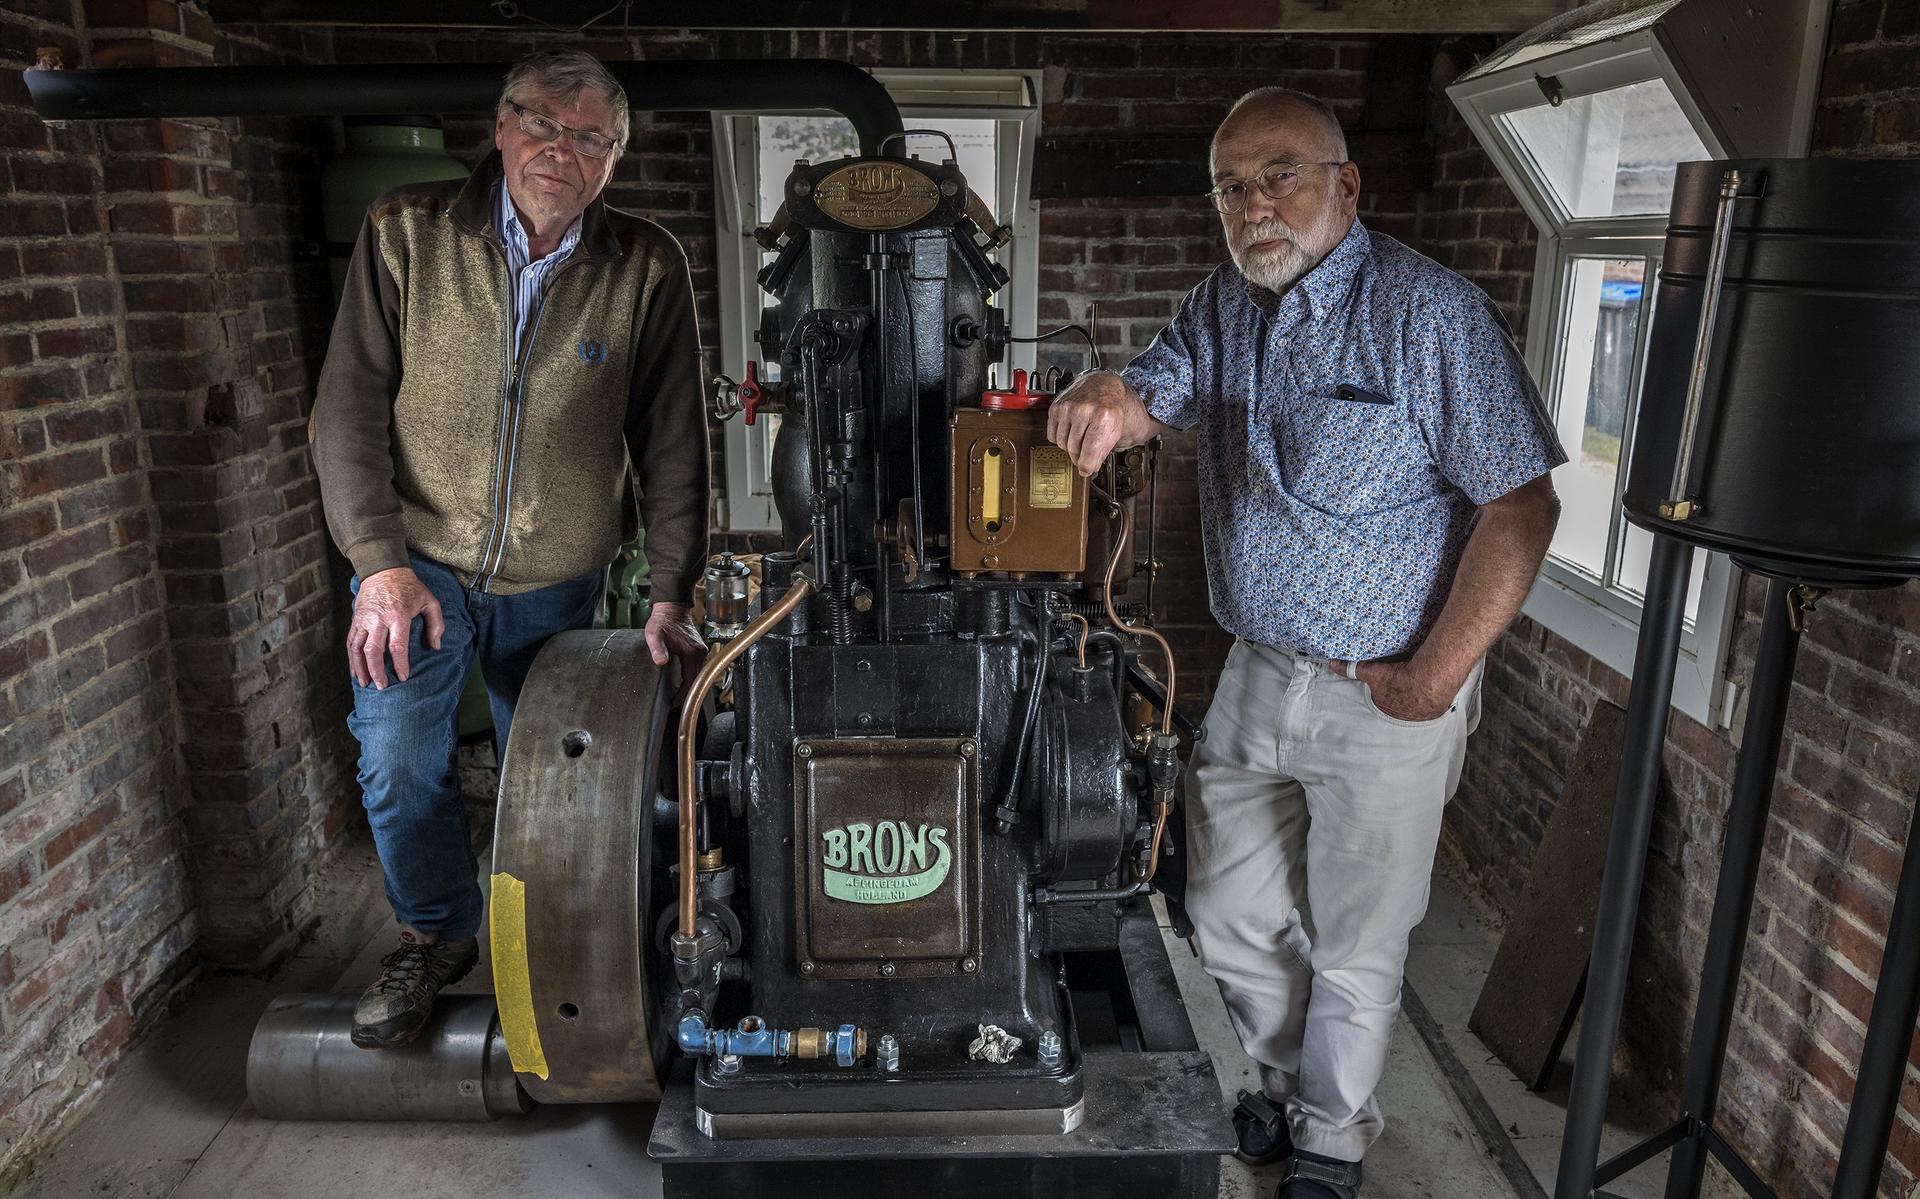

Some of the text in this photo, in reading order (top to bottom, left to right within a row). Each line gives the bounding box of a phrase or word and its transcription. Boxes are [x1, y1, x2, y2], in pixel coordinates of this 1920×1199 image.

[823, 821, 951, 874] BRONS
[845, 877, 919, 889] APPINGEDAM
[856, 890, 907, 900] HOLLAND
